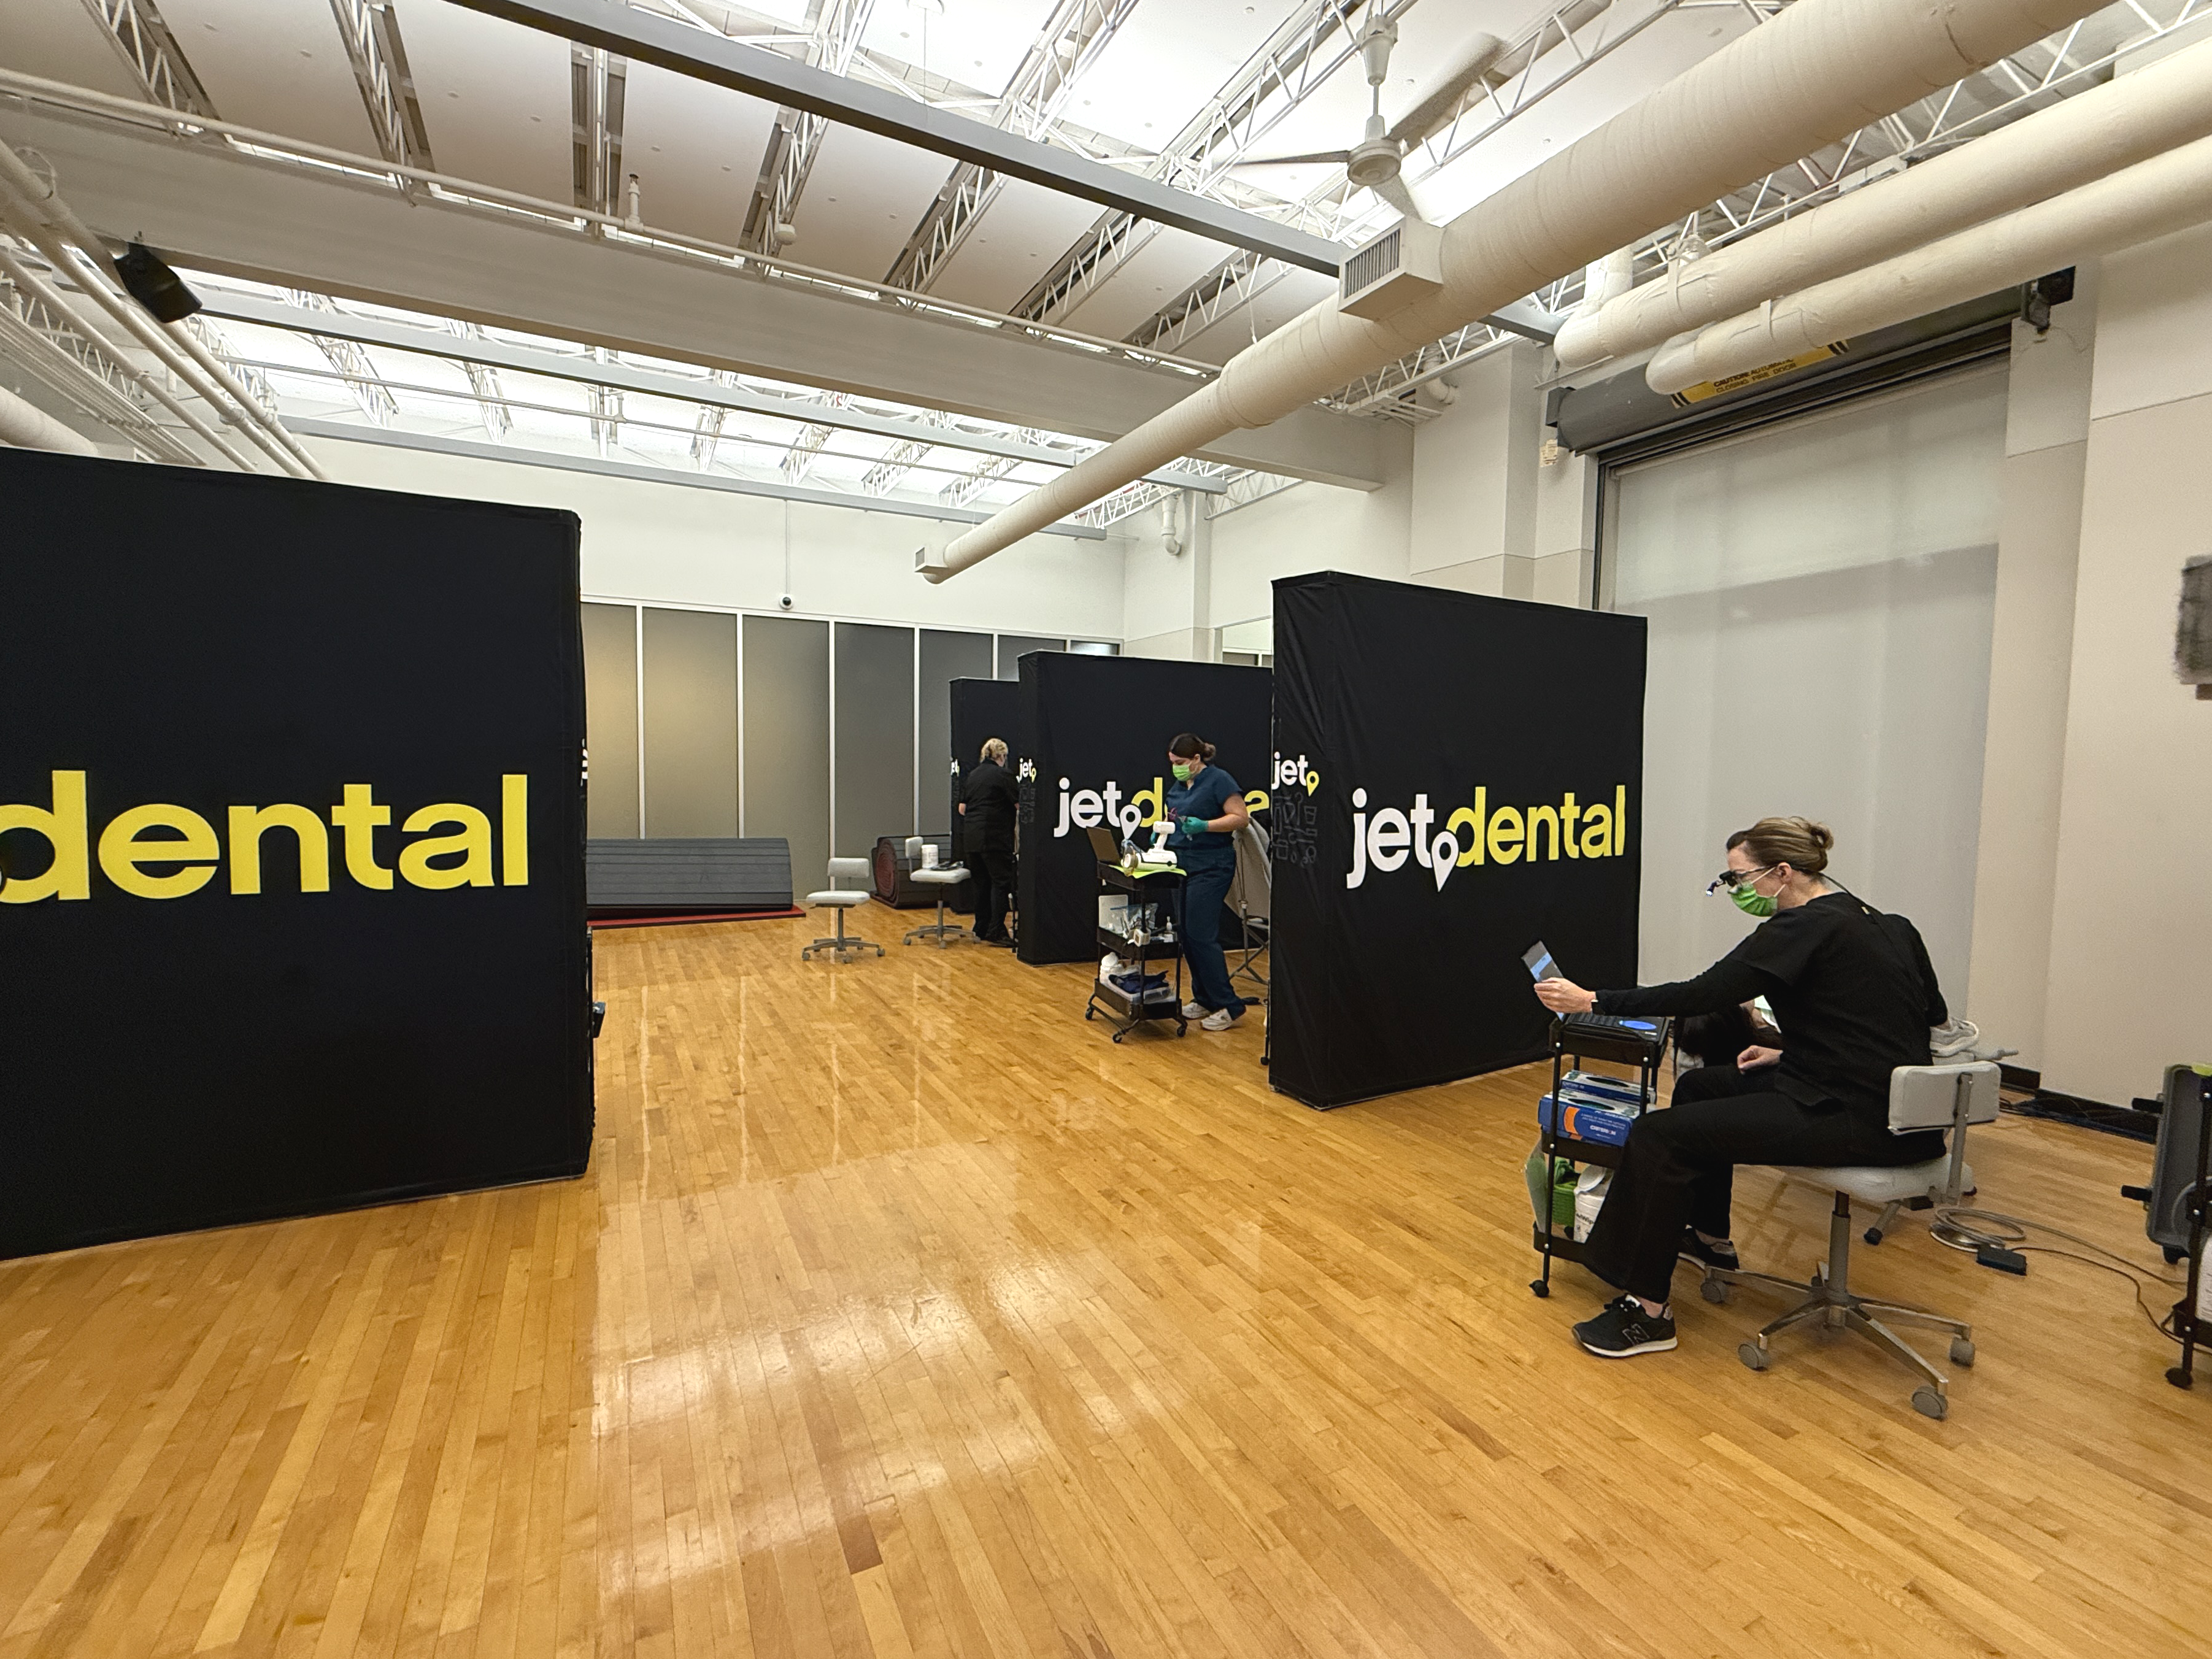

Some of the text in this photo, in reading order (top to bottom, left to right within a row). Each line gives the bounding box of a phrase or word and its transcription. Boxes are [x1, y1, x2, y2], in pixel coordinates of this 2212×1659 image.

[1773, 363, 1796, 374] DOOR
[1016, 758, 1033, 783] jet
[1272, 752, 1308, 790] jet
[1054, 777, 1122, 838] jet
[1347, 788, 1435, 889] jet
[1446, 785, 1625, 868] dental
